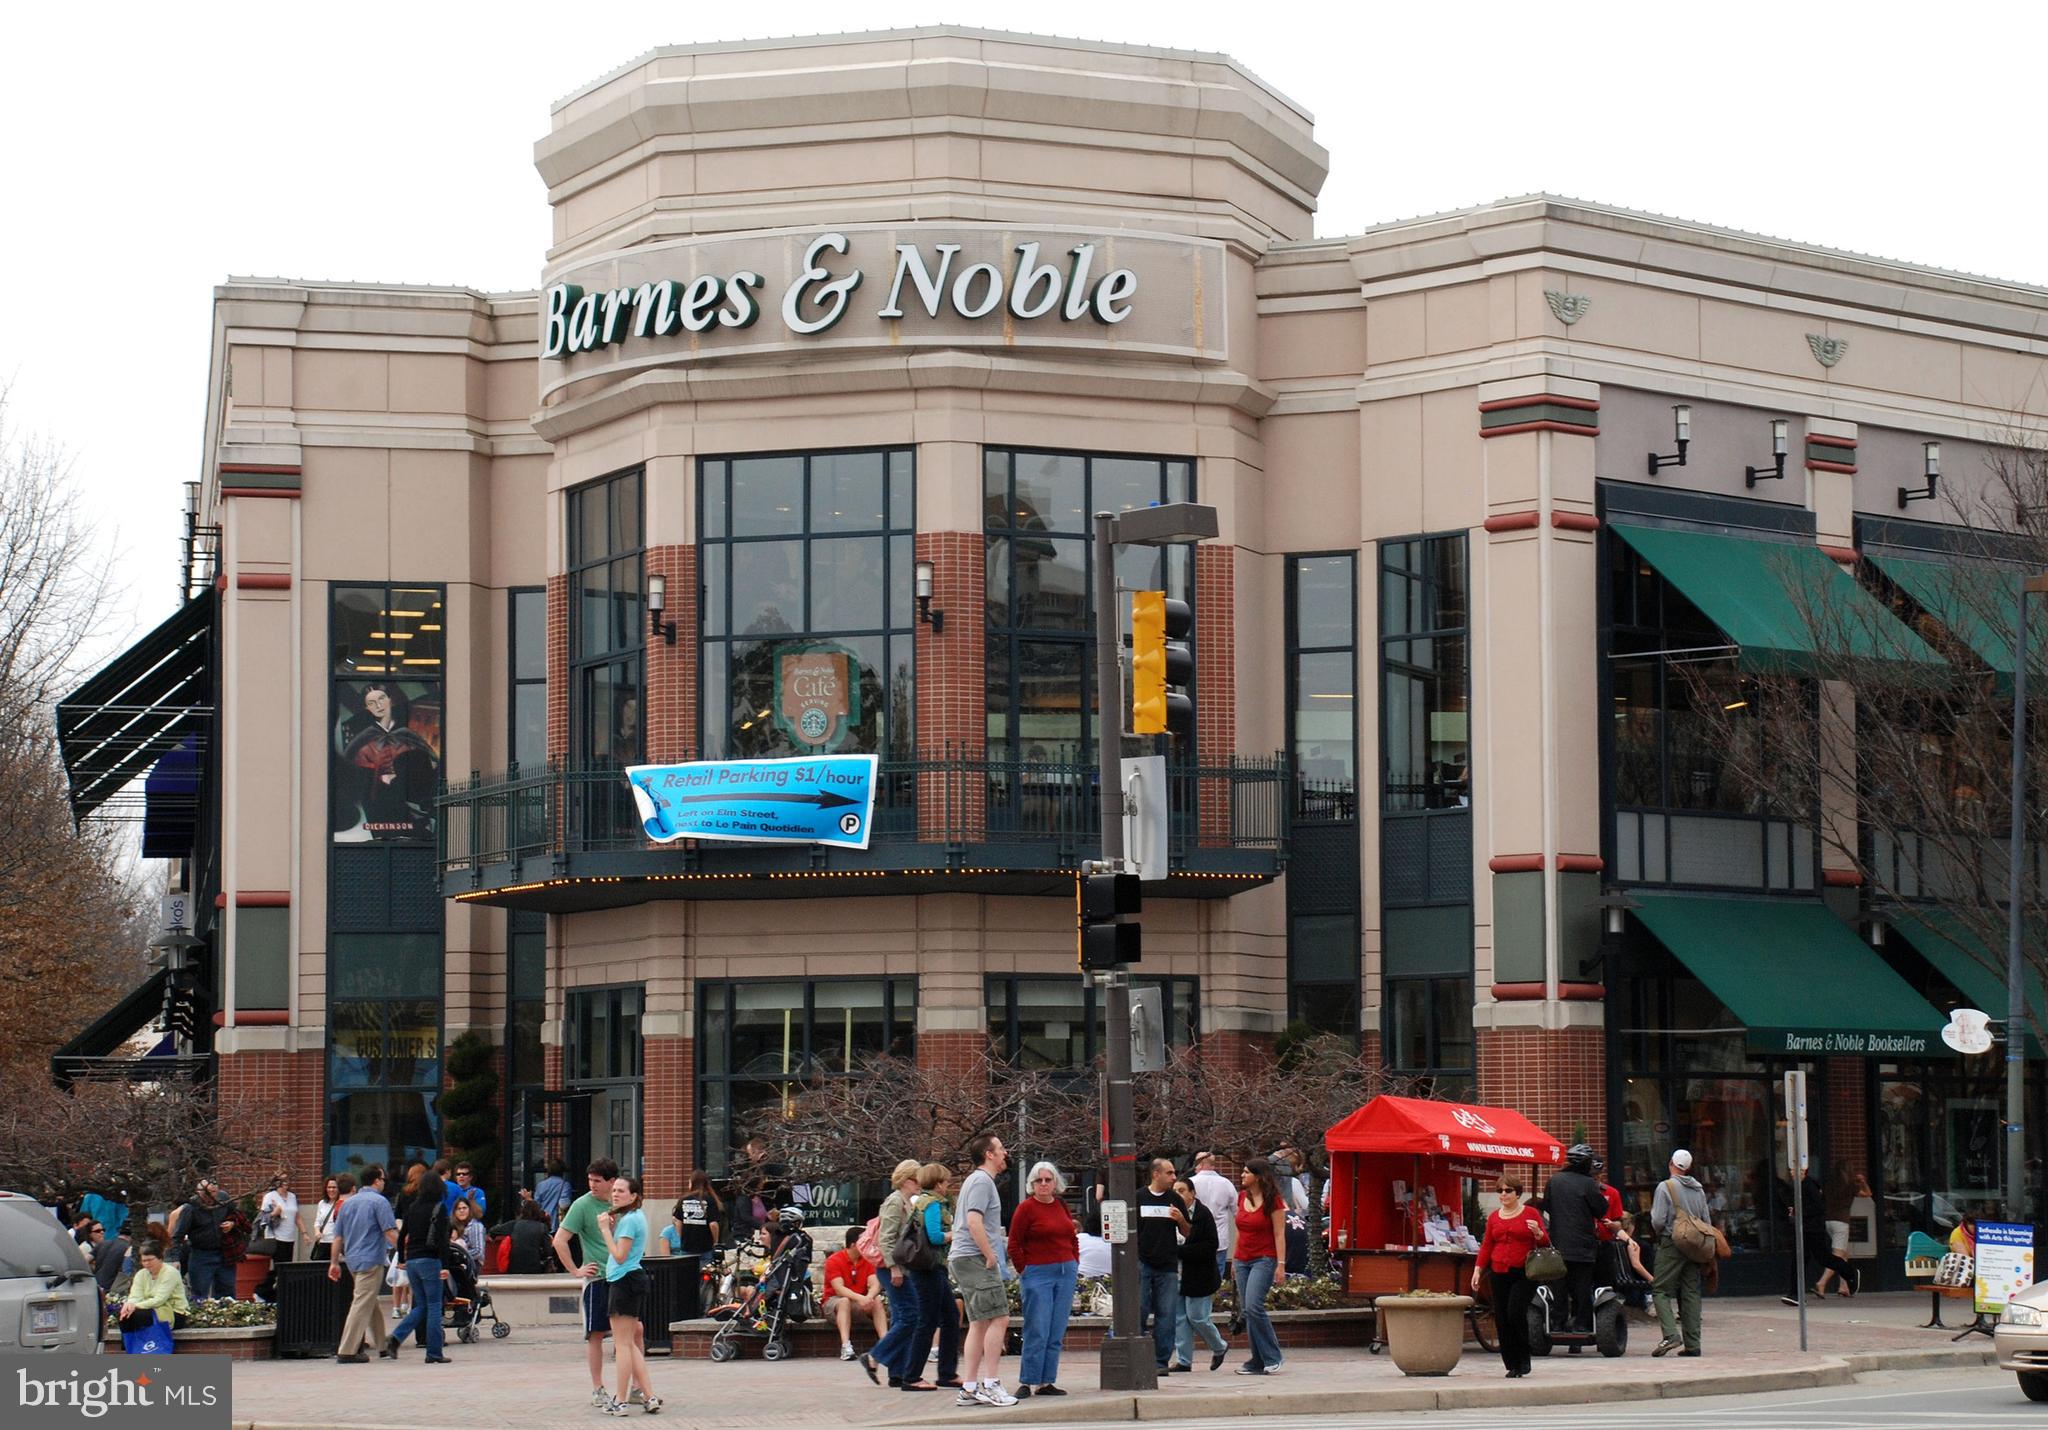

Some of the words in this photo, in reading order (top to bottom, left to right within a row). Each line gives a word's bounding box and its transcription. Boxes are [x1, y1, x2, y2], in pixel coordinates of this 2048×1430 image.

[541, 271, 764, 360] Barnes
[782, 232, 864, 335] &
[878, 241, 1138, 325] Noble
[793, 676, 836, 697] Café
[663, 769, 714, 788] Retail
[718, 766, 789, 787] Parking
[795, 764, 864, 785] $1/hour
[678, 809, 698, 818] Left
[717, 808, 737, 817] Elm
[740, 809, 779, 820] Street,
[365, 823, 414, 831] DICKINSON
[674, 820, 698, 828] next
[701, 820, 713, 828] to
[716, 820, 729, 829] Le
[732, 821, 757, 831] Pain
[760, 822, 815, 833] Quotidien
[845, 817, 857, 831] P
[356, 1037, 423, 1058] CUSOMER
[1785, 1033, 1823, 1051] Barnes
[1825, 1034, 1833, 1051] &
[1834, 1033, 1865, 1051] Noble
[1867, 1034, 1926, 1052] Booksellers
[1466, 1142, 1535, 1157] WWW.BETHESDA.ORG
[803, 1210, 820, 1218] ERY
[823, 1210, 841, 1218] DAY
